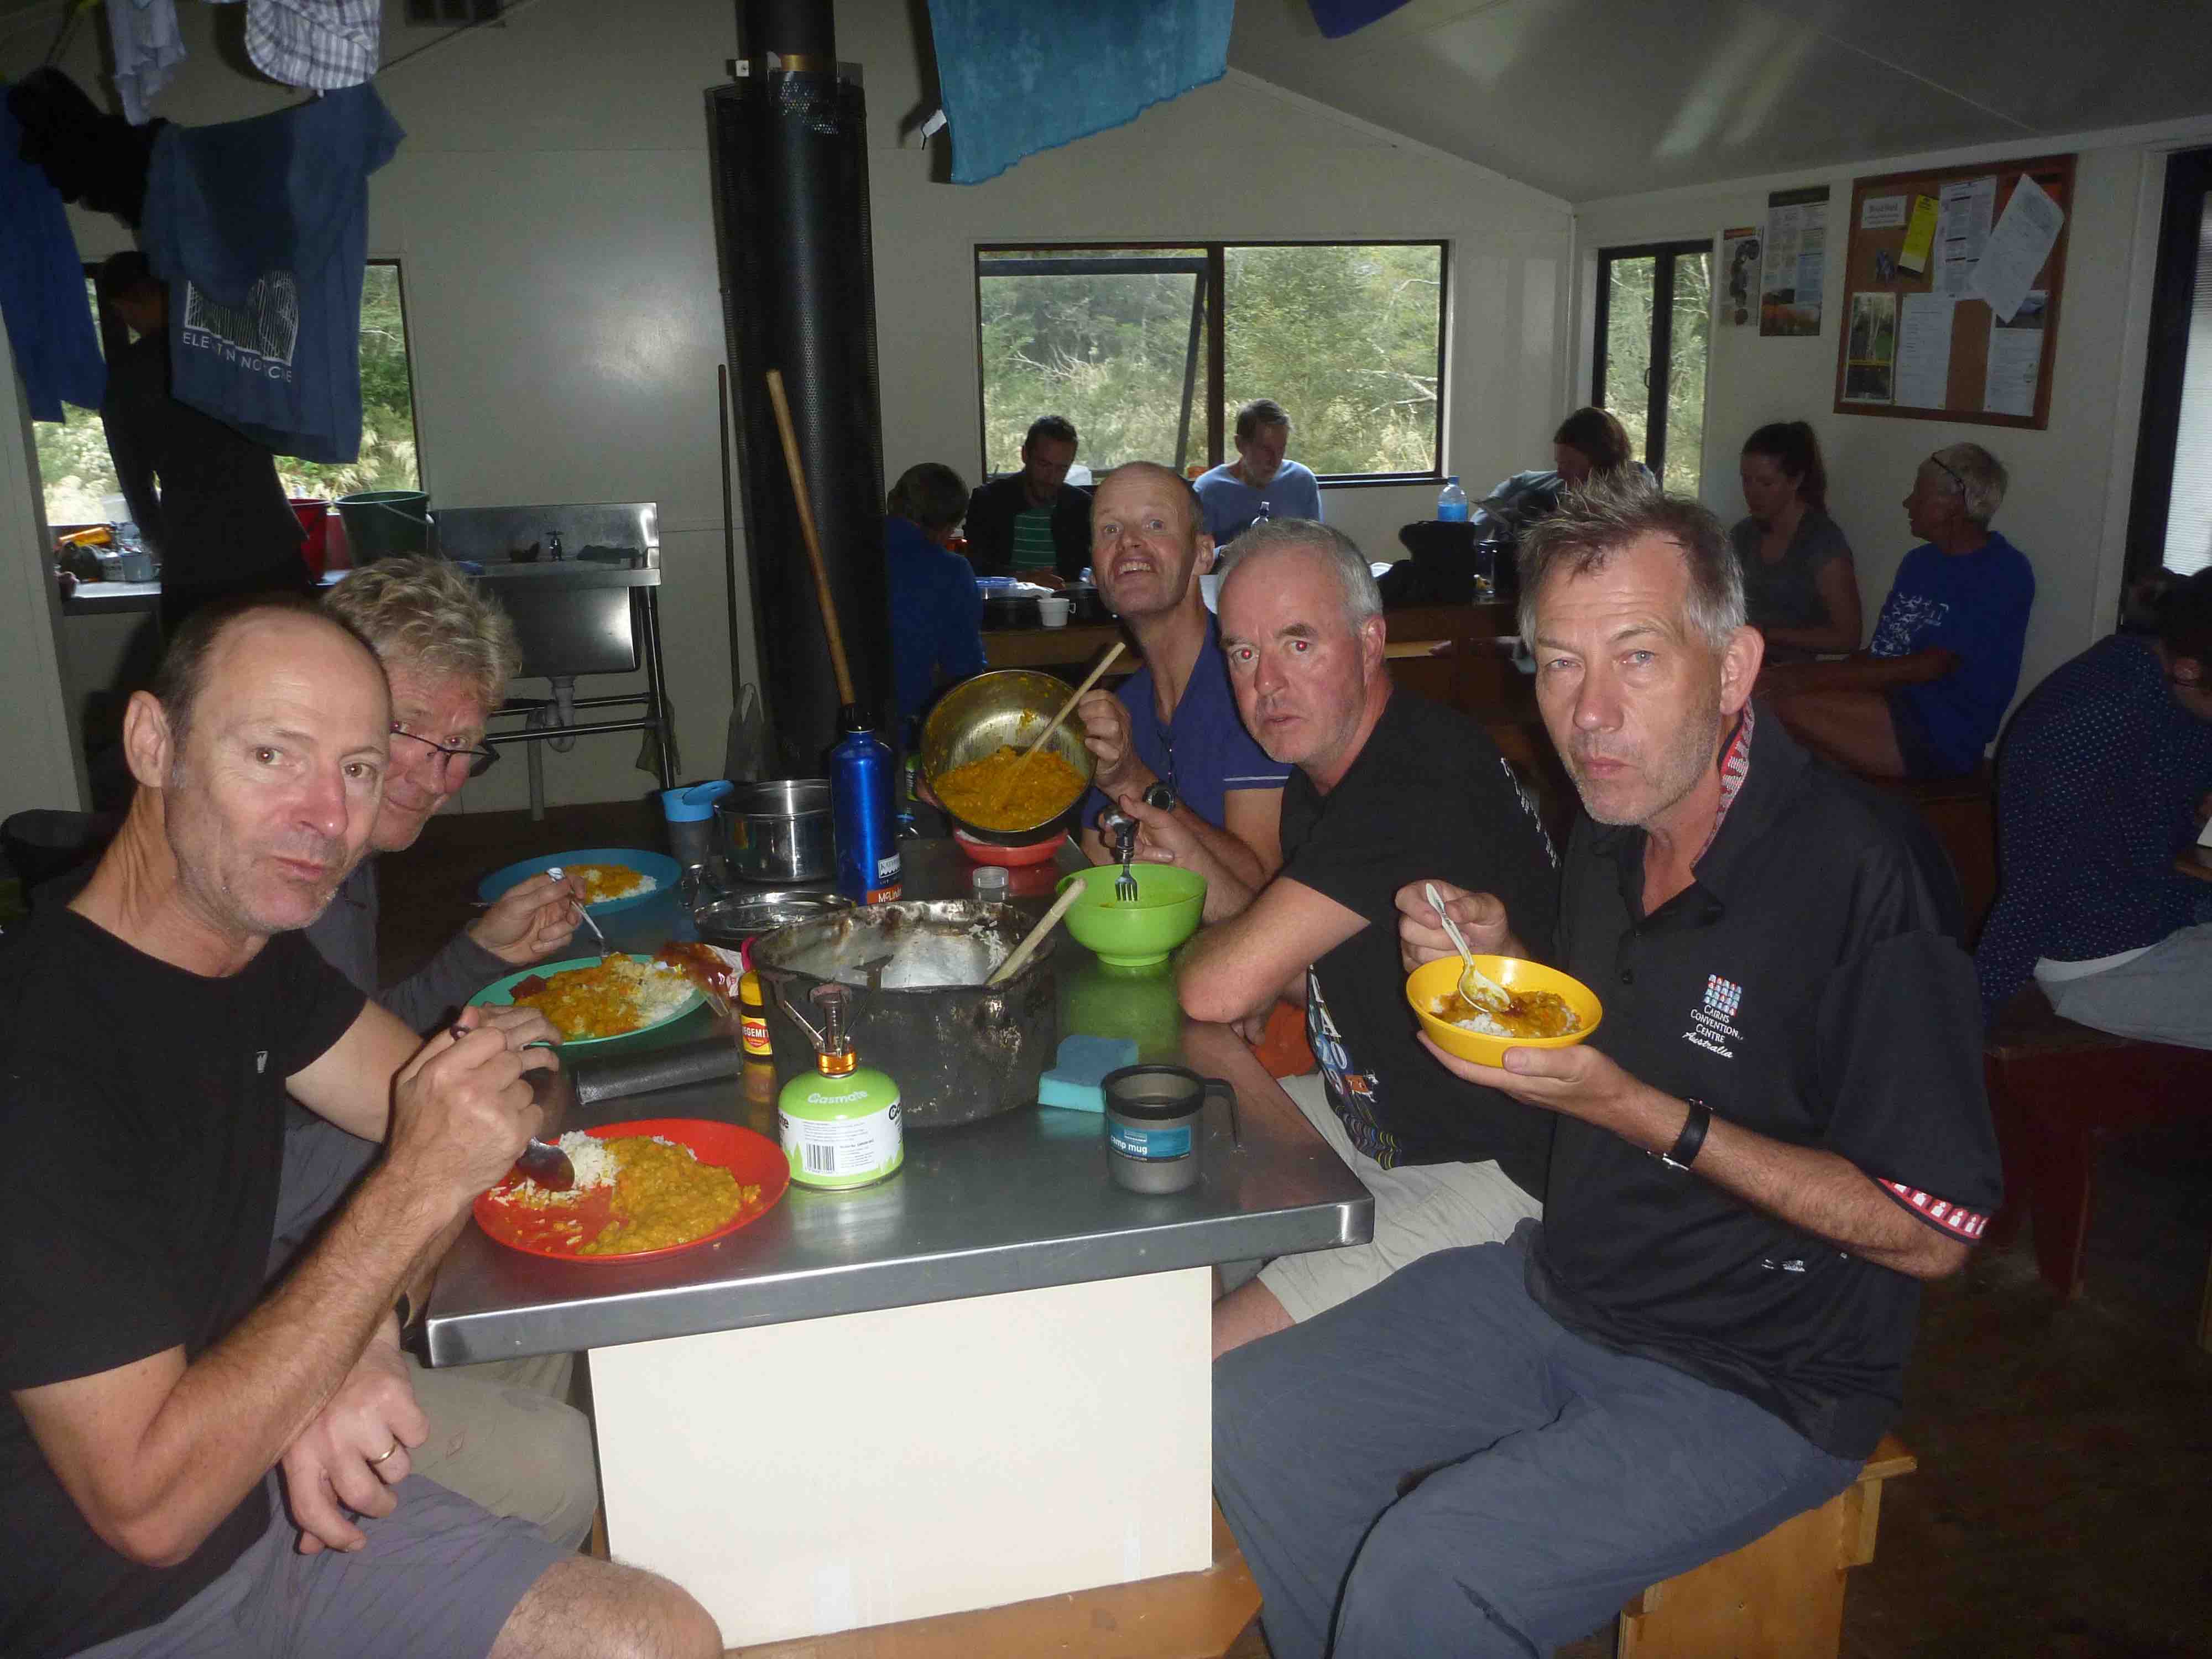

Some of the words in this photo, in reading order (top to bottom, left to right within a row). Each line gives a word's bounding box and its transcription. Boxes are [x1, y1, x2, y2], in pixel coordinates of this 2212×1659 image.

[1690, 1009, 1739, 1037] CONVENTION
[1704, 1005, 1729, 1023] CAIRNS
[1695, 1023, 1725, 1043] CENTRE
[1682, 1031, 1734, 1058] Australia
[807, 1090, 868, 1104] Gasmate
[1128, 1143, 1147, 1155] mug
